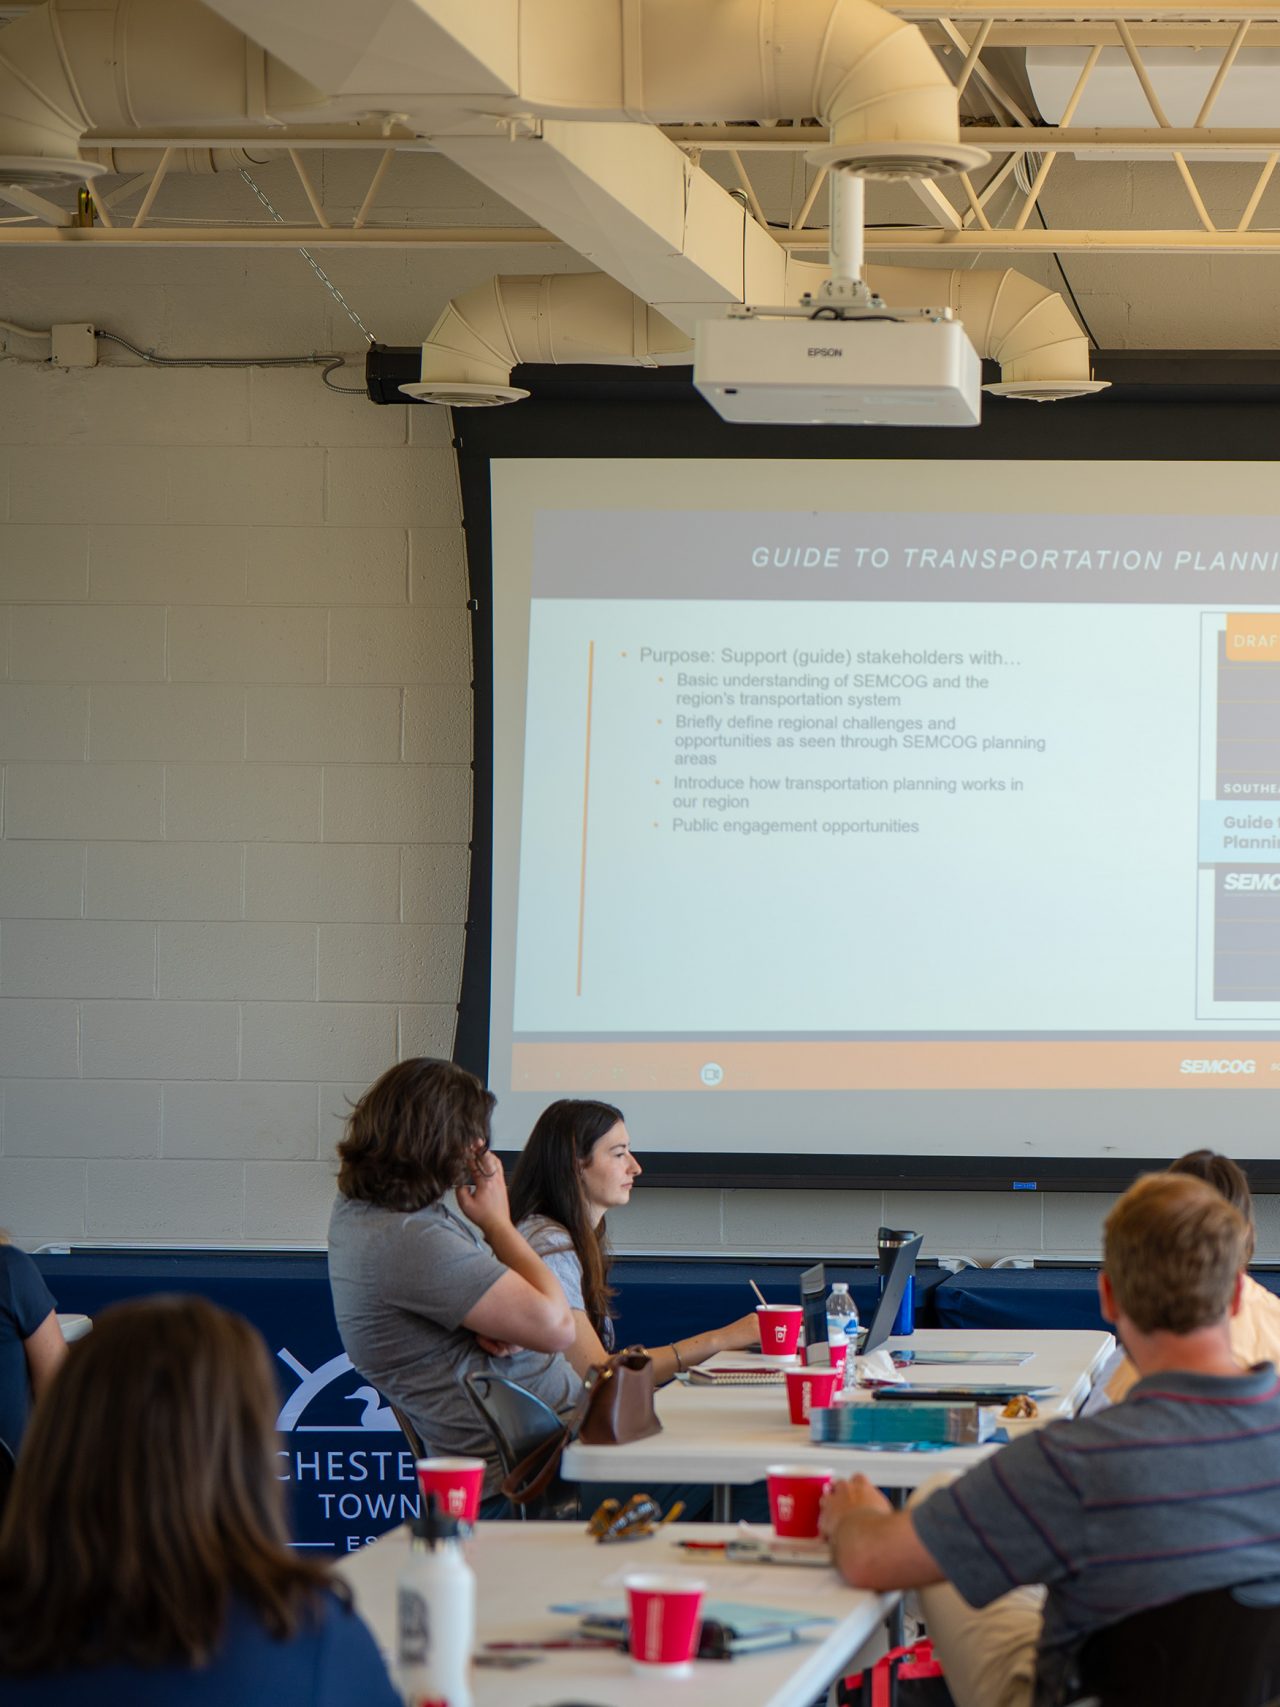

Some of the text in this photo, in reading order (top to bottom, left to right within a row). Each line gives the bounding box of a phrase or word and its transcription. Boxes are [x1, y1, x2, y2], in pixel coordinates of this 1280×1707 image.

[808, 348, 842, 357] EPSON
[752, 547, 840, 568] GUIDE
[856, 548, 890, 569] TO
[904, 548, 1161, 571] TRANSPORTATION
[640, 646, 714, 666] Purpose:
[721, 648, 787, 666] Support
[792, 648, 852, 667] (guide)
[856, 650, 964, 665] stakeholders
[677, 672, 989, 690] Basic understanding of SEMCOG and the
[740, 692, 843, 708] transportation
[848, 694, 901, 710] system
[676, 714, 956, 732] Briefly define regional challenges and
[674, 734, 1046, 752] opportunities as seen through SEMCOG planning
[674, 754, 718, 766] areas
[674, 776, 1024, 794] Introduce how transportation planning works in
[672, 795, 750, 812] our region
[672, 818, 920, 836] Public engagement opportunities
[1224, 815, 1274, 830] Guide
[1180, 1059, 1256, 1074] SEMCOG
[276, 1451, 415, 1481] CHESTE
[318, 1493, 421, 1519] TOWN
